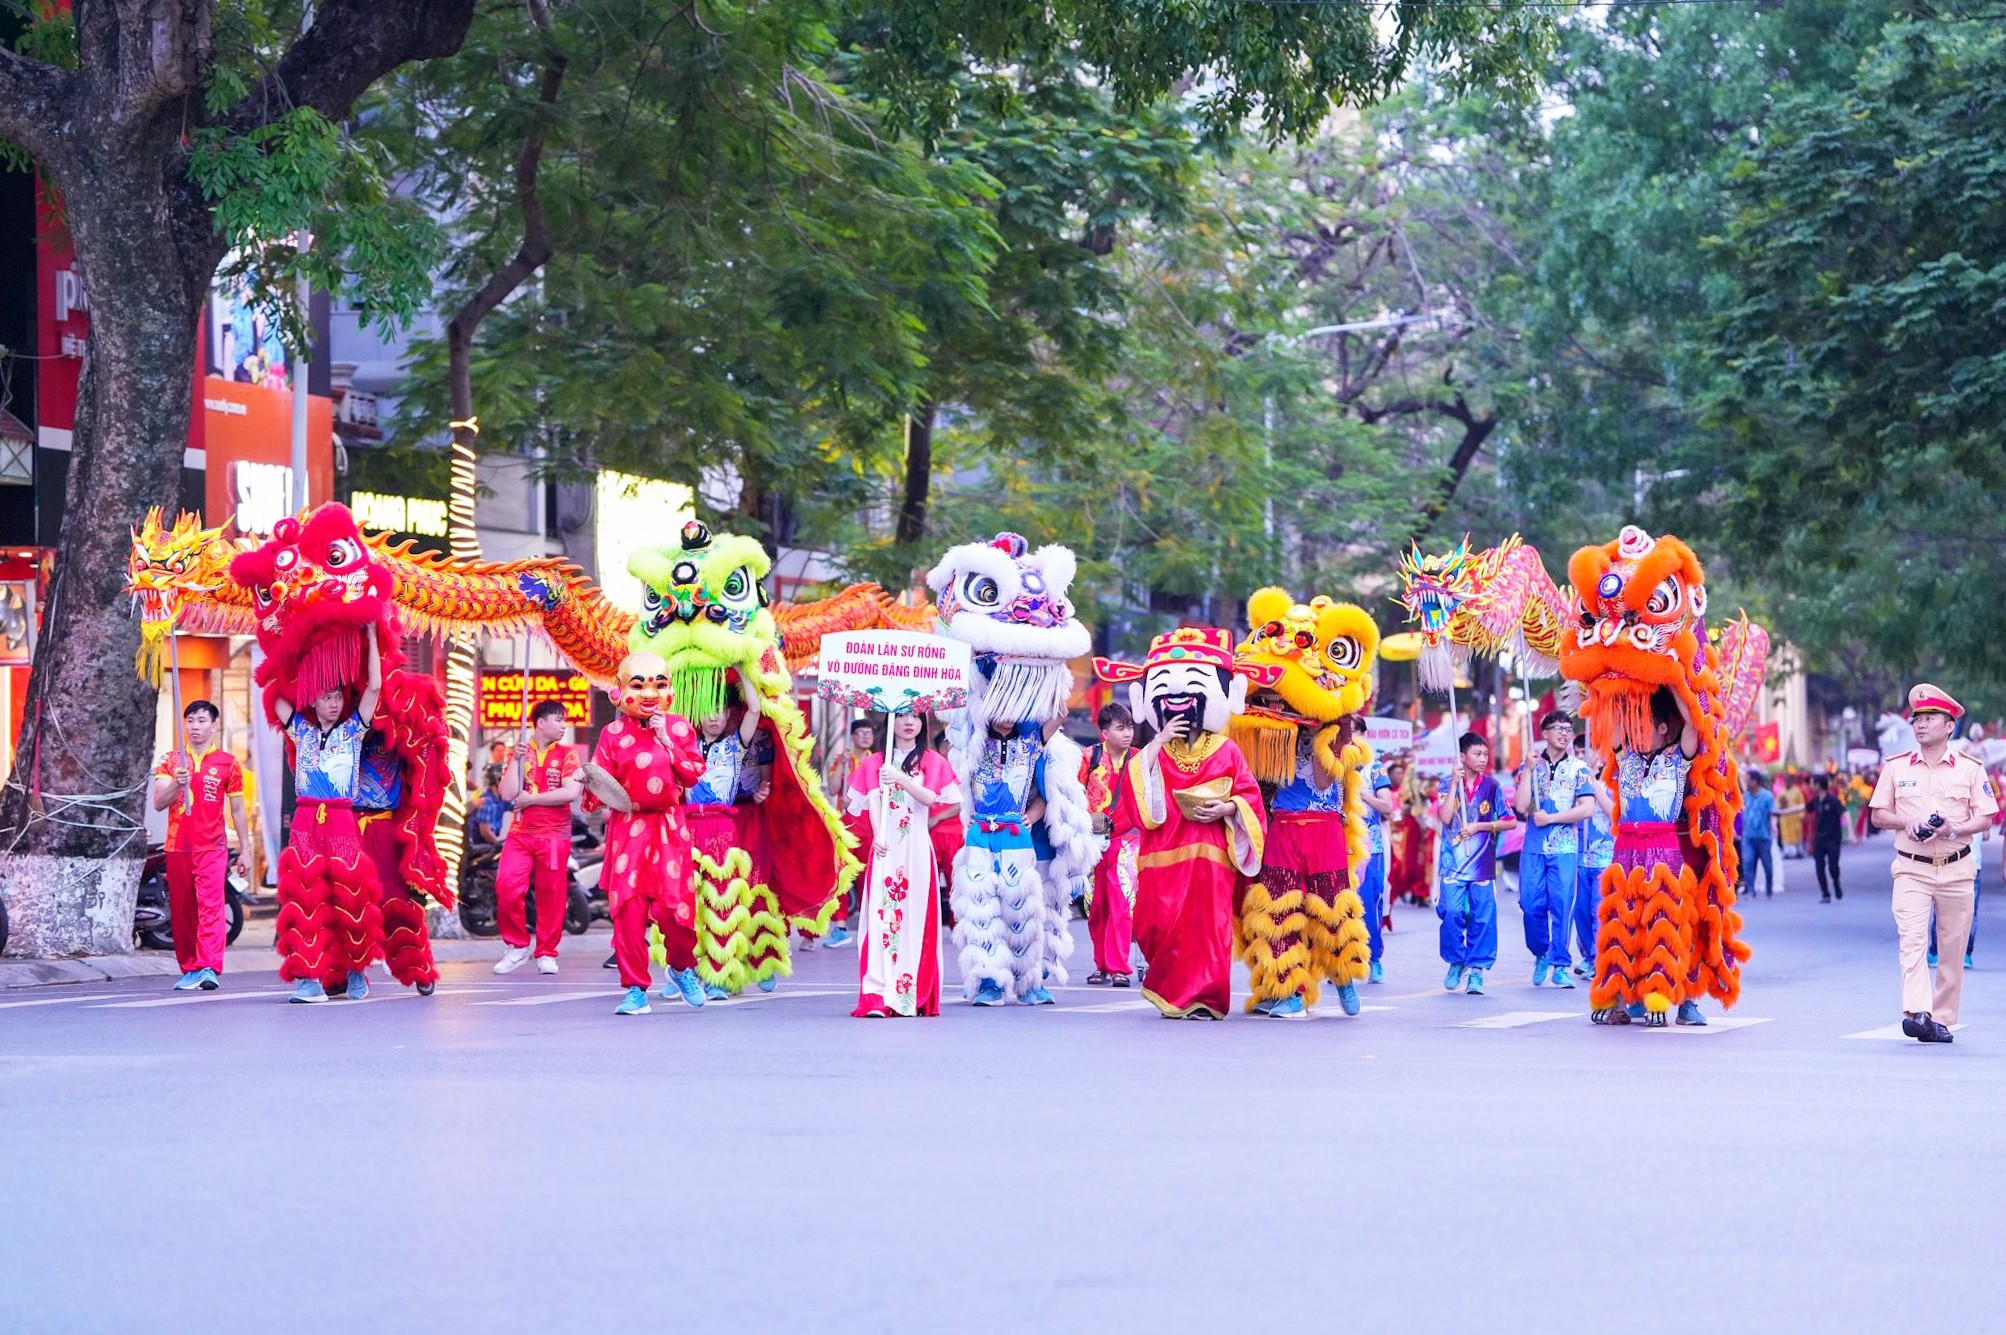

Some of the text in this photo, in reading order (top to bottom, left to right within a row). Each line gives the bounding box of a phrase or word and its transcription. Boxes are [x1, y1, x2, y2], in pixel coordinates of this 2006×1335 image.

[846, 640, 875, 655] ĐOÀN
[878, 642, 898, 656] LÂN
[901, 645, 916, 658] SƯ
[827, 659, 961, 680] VÕ ĐƯỜNG ĐẶNG ĐÌNH HÒA
[535, 676, 559, 691] DA
